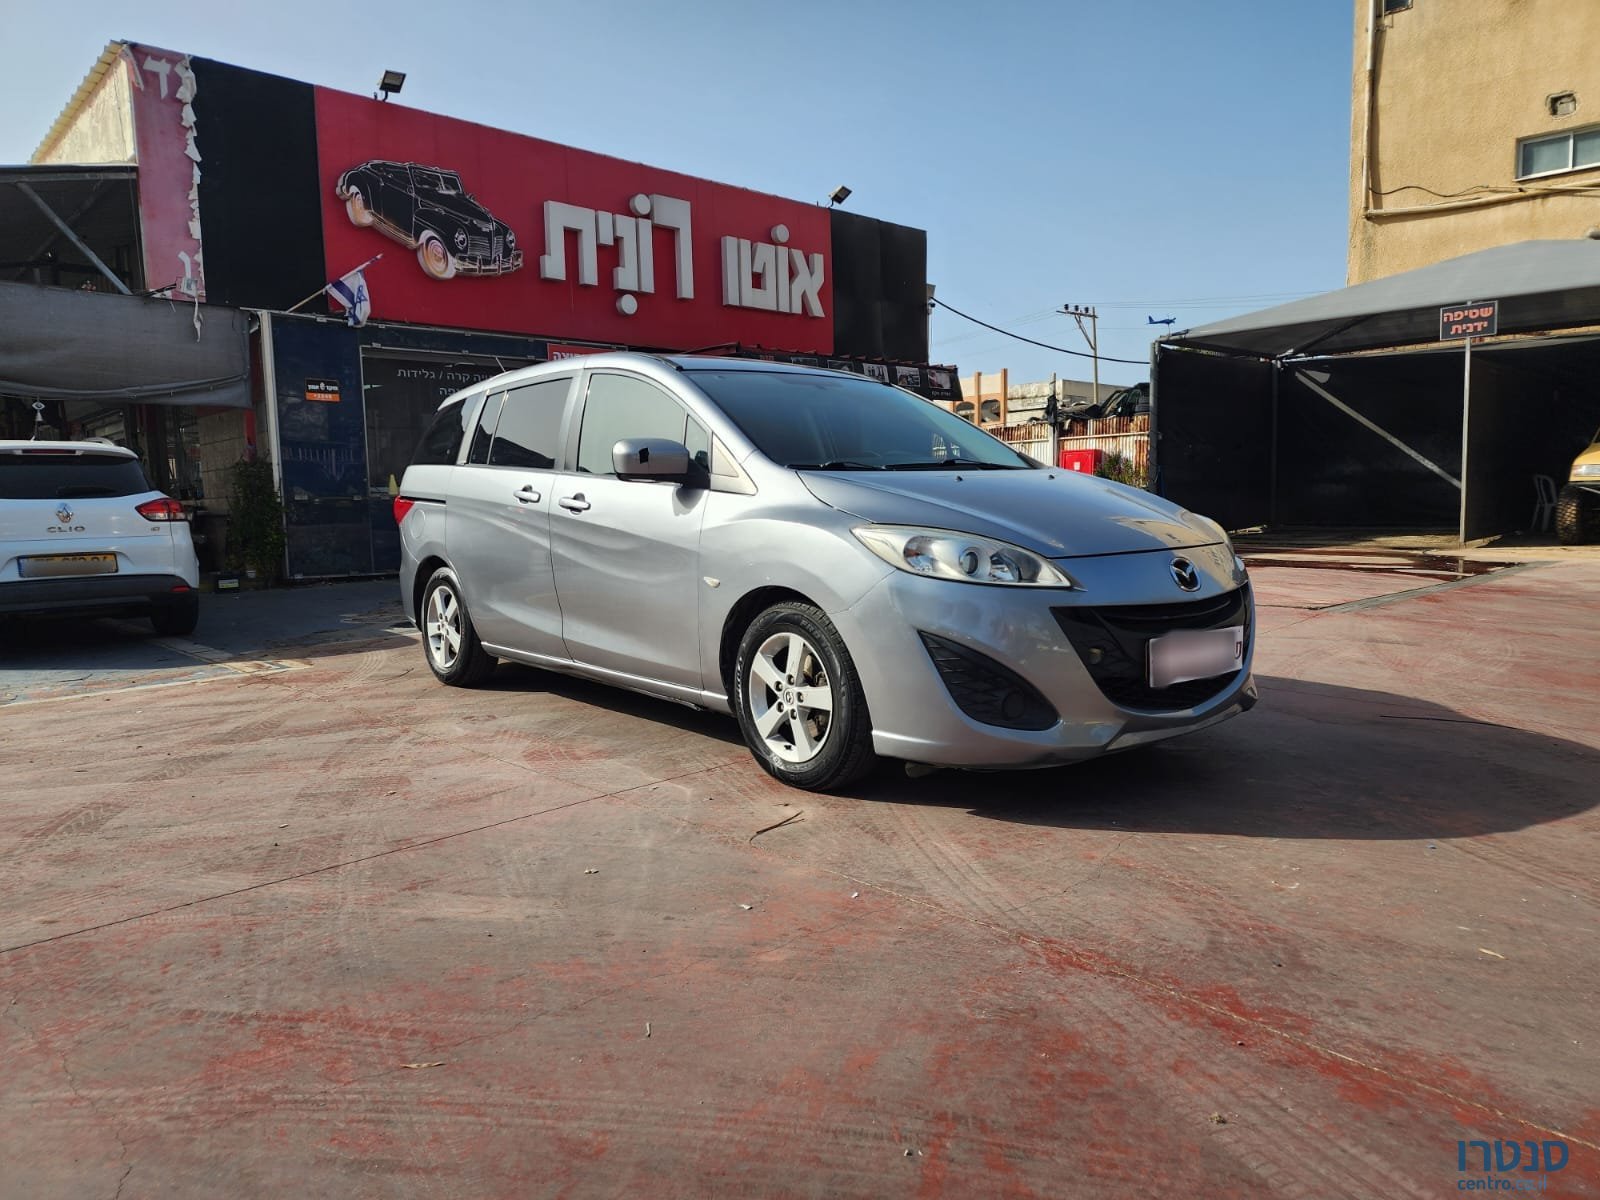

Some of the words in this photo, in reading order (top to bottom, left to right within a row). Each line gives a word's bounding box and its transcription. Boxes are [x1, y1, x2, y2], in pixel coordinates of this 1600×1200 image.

[1443, 306, 1494, 322] שטיפה
[1450, 320, 1488, 335] ידנית
[396, 368, 436, 380] גלידות
[447, 372, 470, 383] קרה
